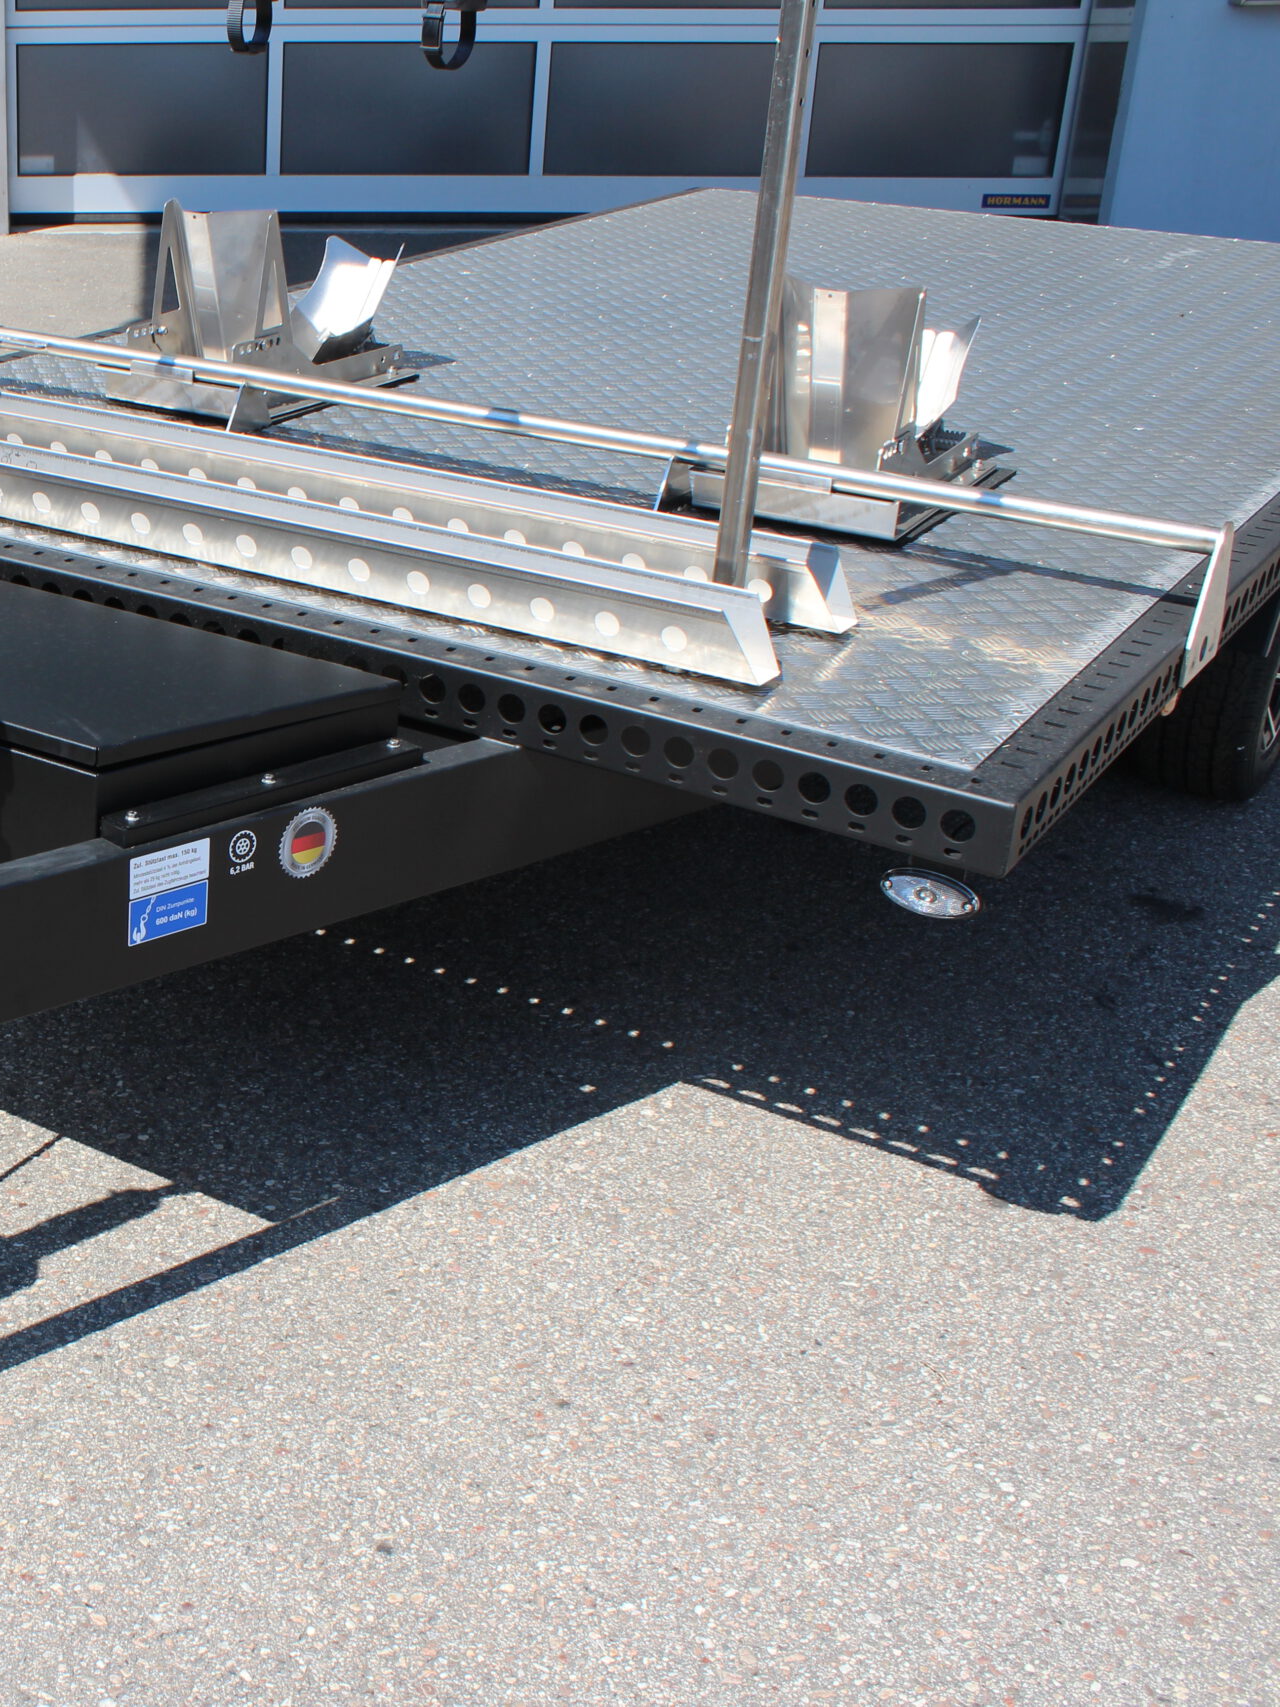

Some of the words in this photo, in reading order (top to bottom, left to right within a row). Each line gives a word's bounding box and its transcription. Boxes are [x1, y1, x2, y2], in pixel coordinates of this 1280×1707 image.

[229, 865, 241, 876] 6,2
[241, 861, 255, 872] BAR
[155, 905, 166, 913] DIN
[155, 915, 168, 926] 600
[169, 911, 183, 922] daN
[184, 906, 198, 919] (kg)
